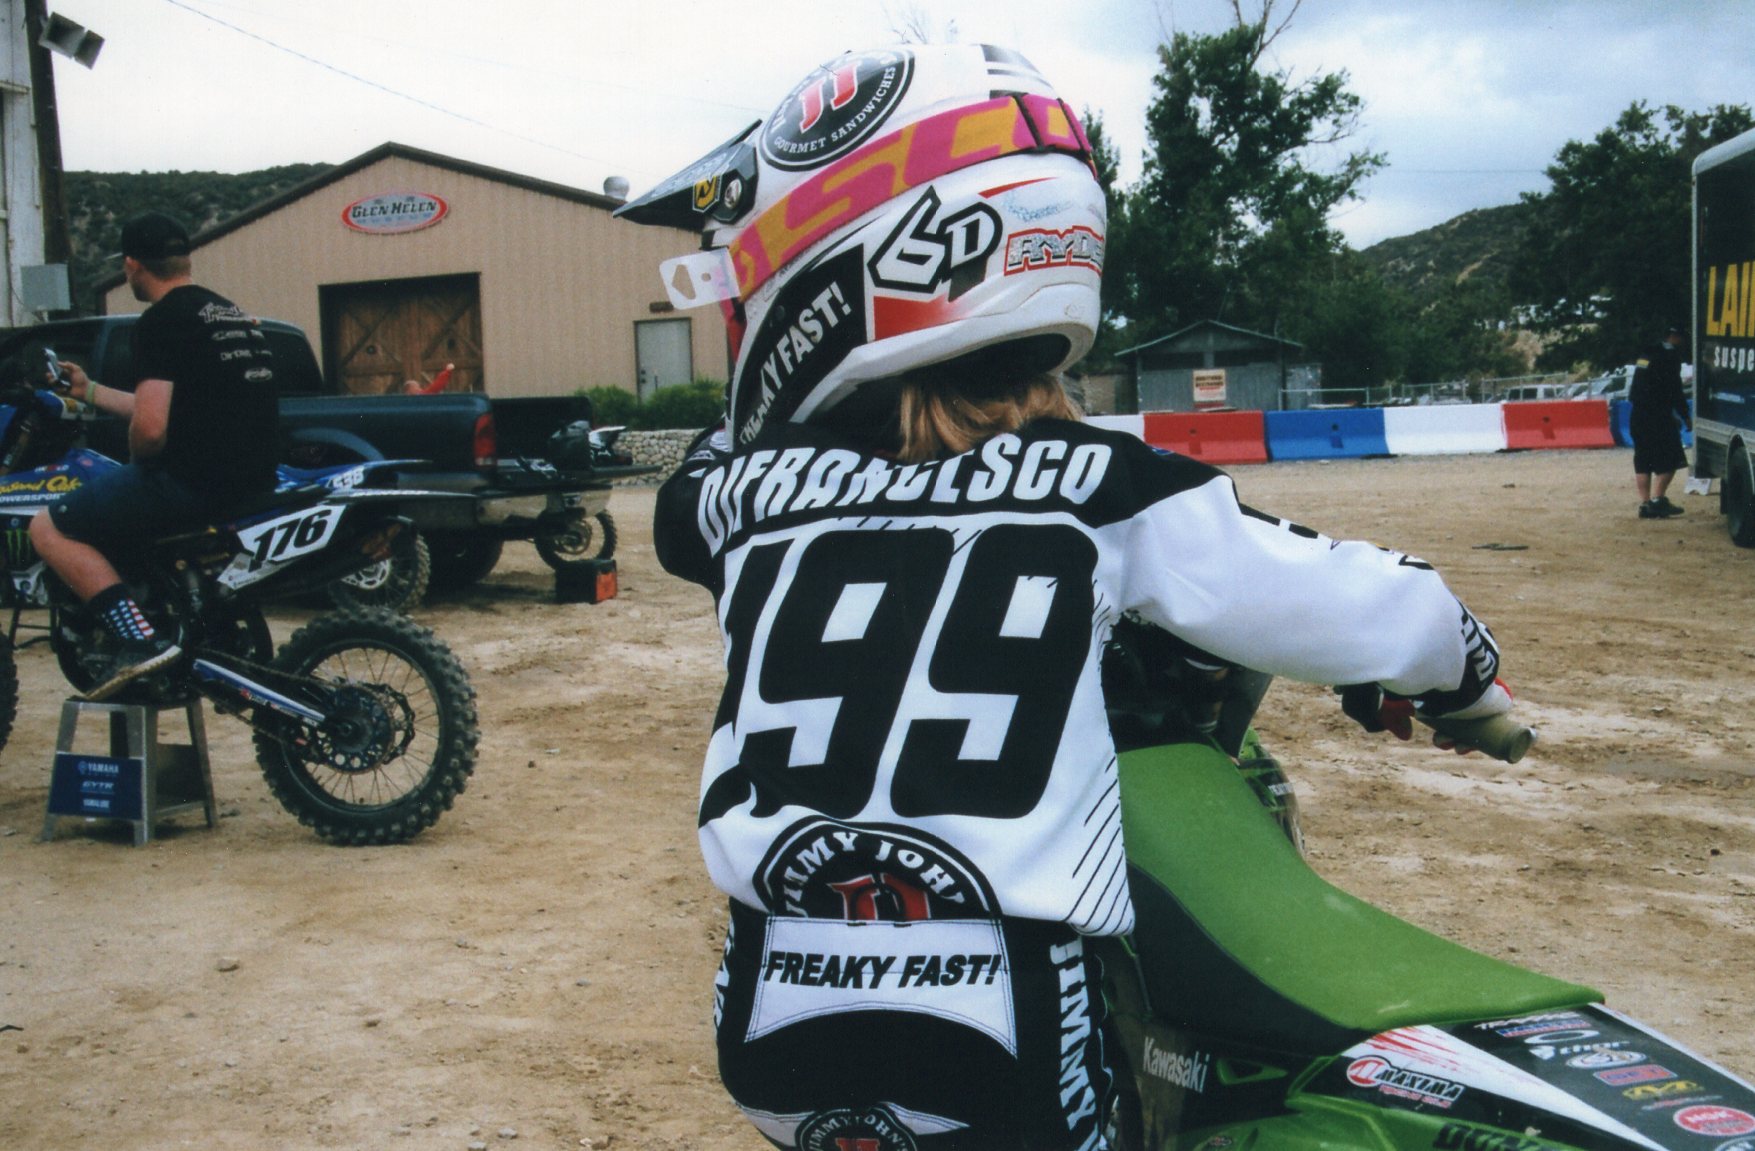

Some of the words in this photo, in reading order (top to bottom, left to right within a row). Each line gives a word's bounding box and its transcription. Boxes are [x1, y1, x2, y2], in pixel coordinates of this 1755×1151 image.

[774, 135, 827, 154] GOURMET
[831, 66, 896, 142] SANDWICHES
[391, 201, 437, 215] HELEN
[776, 281, 852, 376] FAST!
[248, 509, 332, 573] 176
[712, 523, 1099, 820] 199
[88, 762, 119, 774] YAMAHA
[763, 950, 897, 989] FREAKY
[898, 953, 1002, 988] FAST!
[1142, 1036, 1210, 1094] Kawasaki
